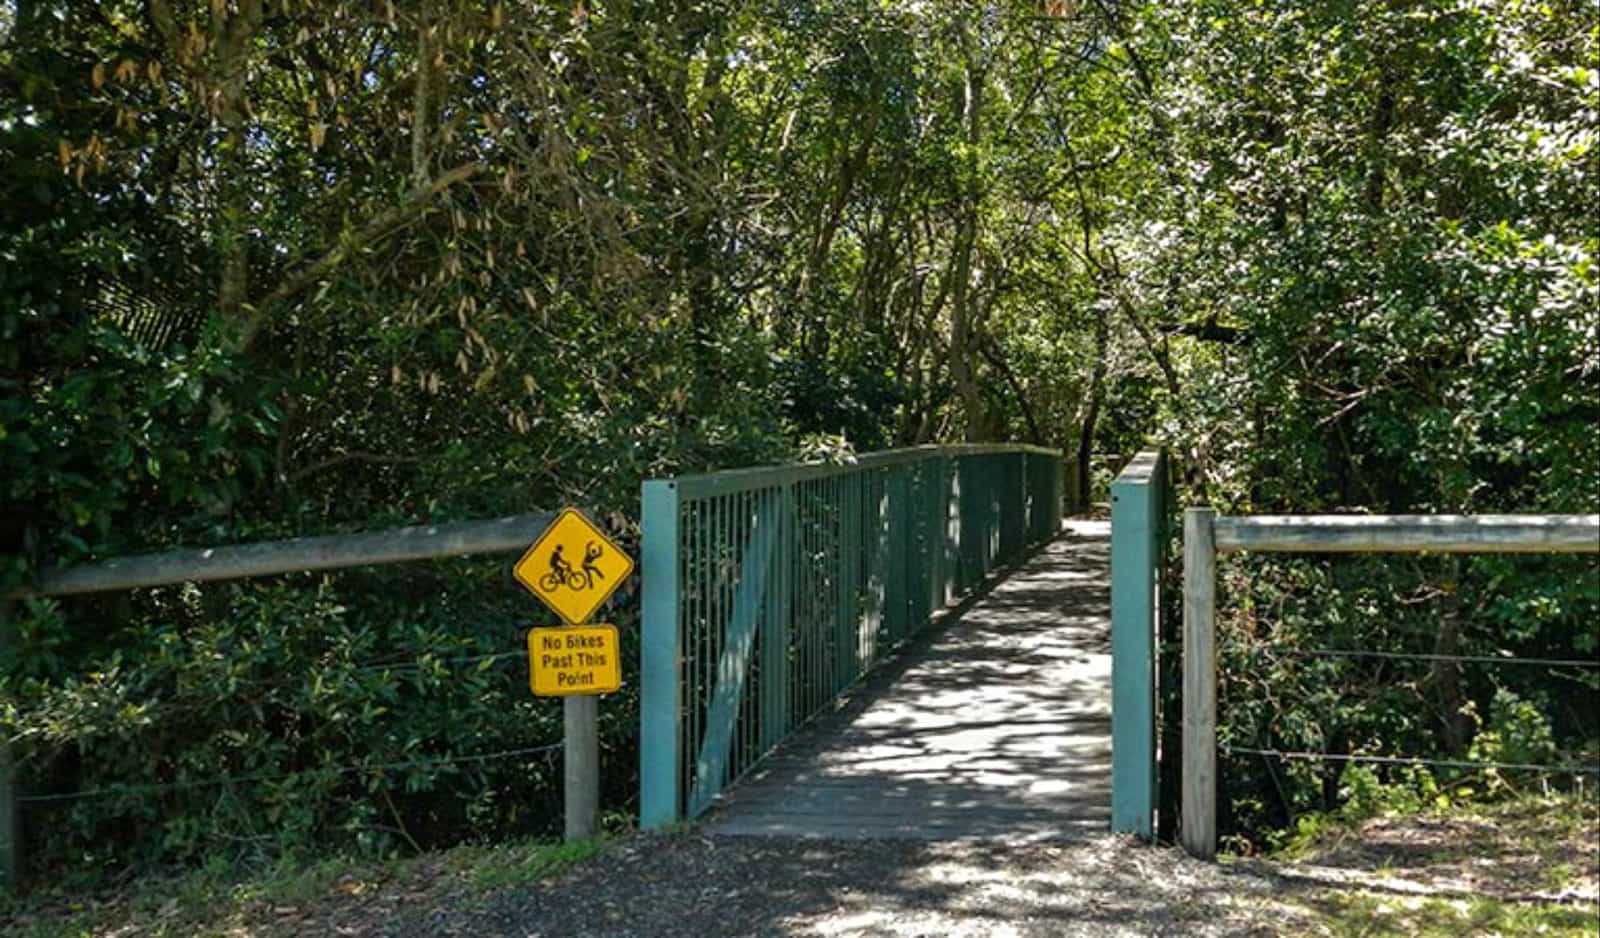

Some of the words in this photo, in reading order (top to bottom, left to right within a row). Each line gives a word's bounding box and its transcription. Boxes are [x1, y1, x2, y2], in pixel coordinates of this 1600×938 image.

[543, 637, 561, 650] No
[566, 634, 604, 649] Bikes
[542, 653, 573, 667] Past
[577, 652, 606, 666] This
[558, 671, 593, 686] Point
